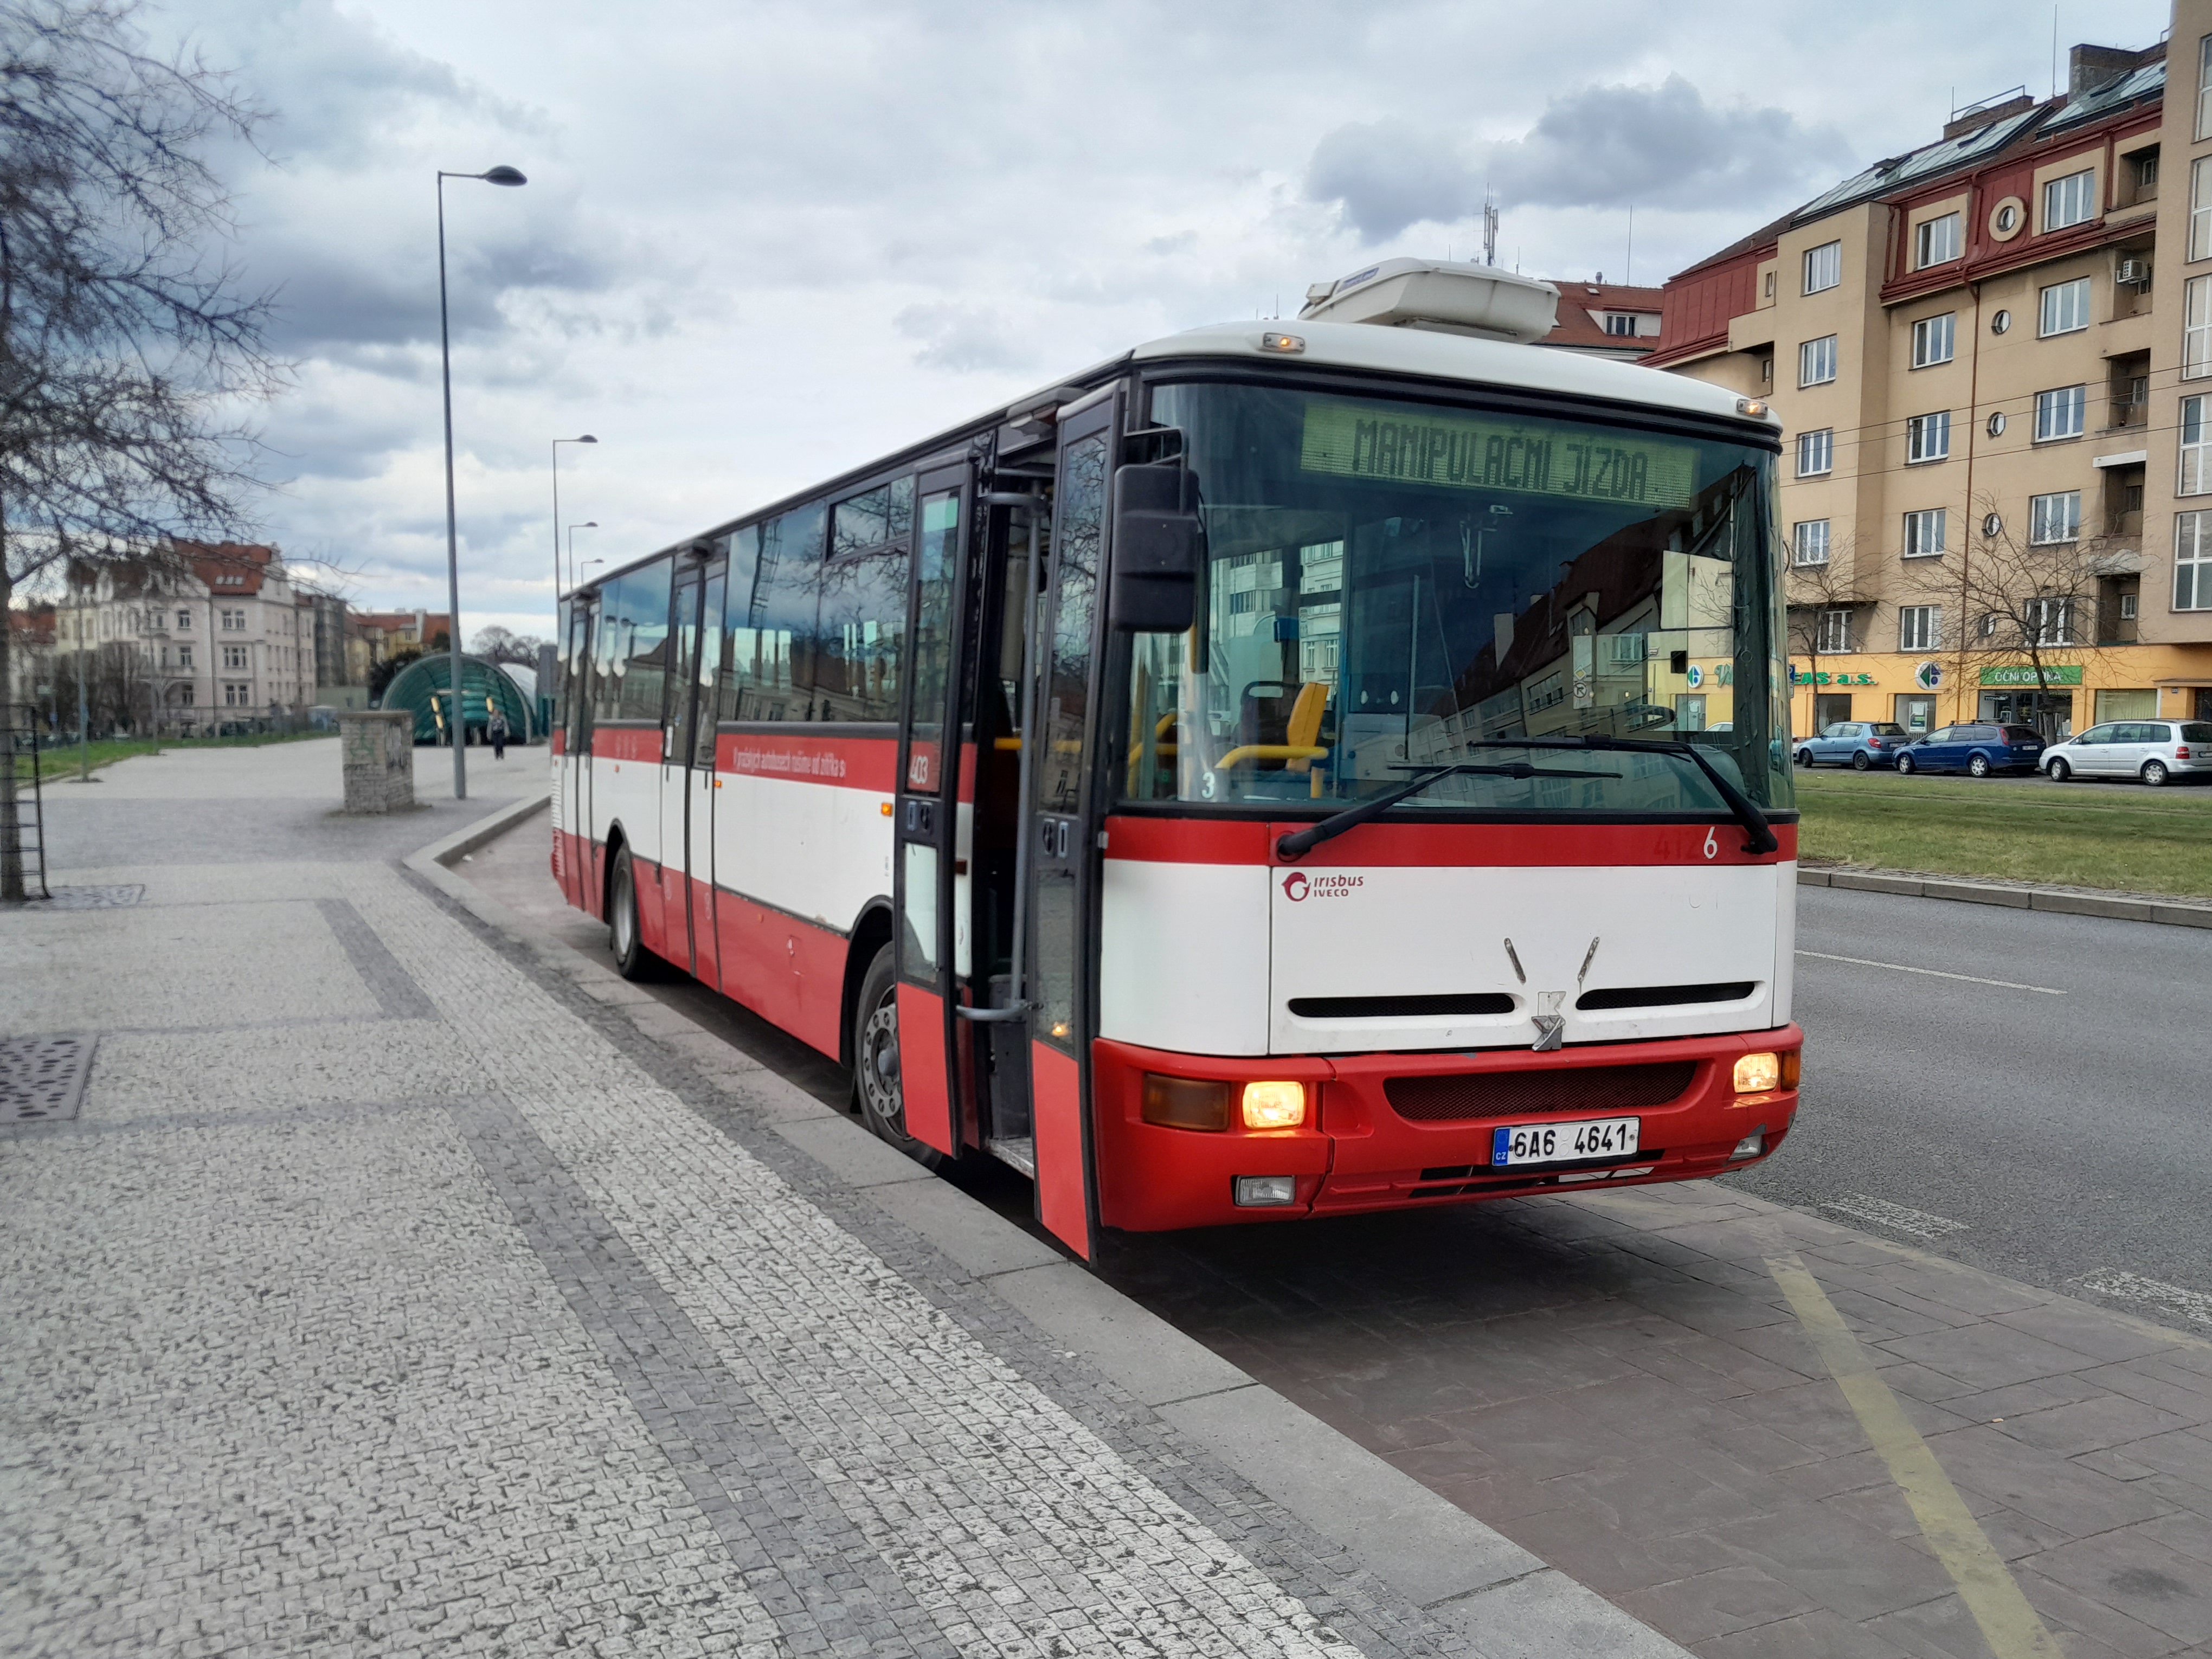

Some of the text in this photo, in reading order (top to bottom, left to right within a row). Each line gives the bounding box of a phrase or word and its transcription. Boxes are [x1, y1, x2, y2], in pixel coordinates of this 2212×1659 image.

[1314, 889, 1349, 897] IVECO
[1514, 1123, 1627, 1158] 6A6 4641
[1495, 1152, 1506, 1161] CZ
